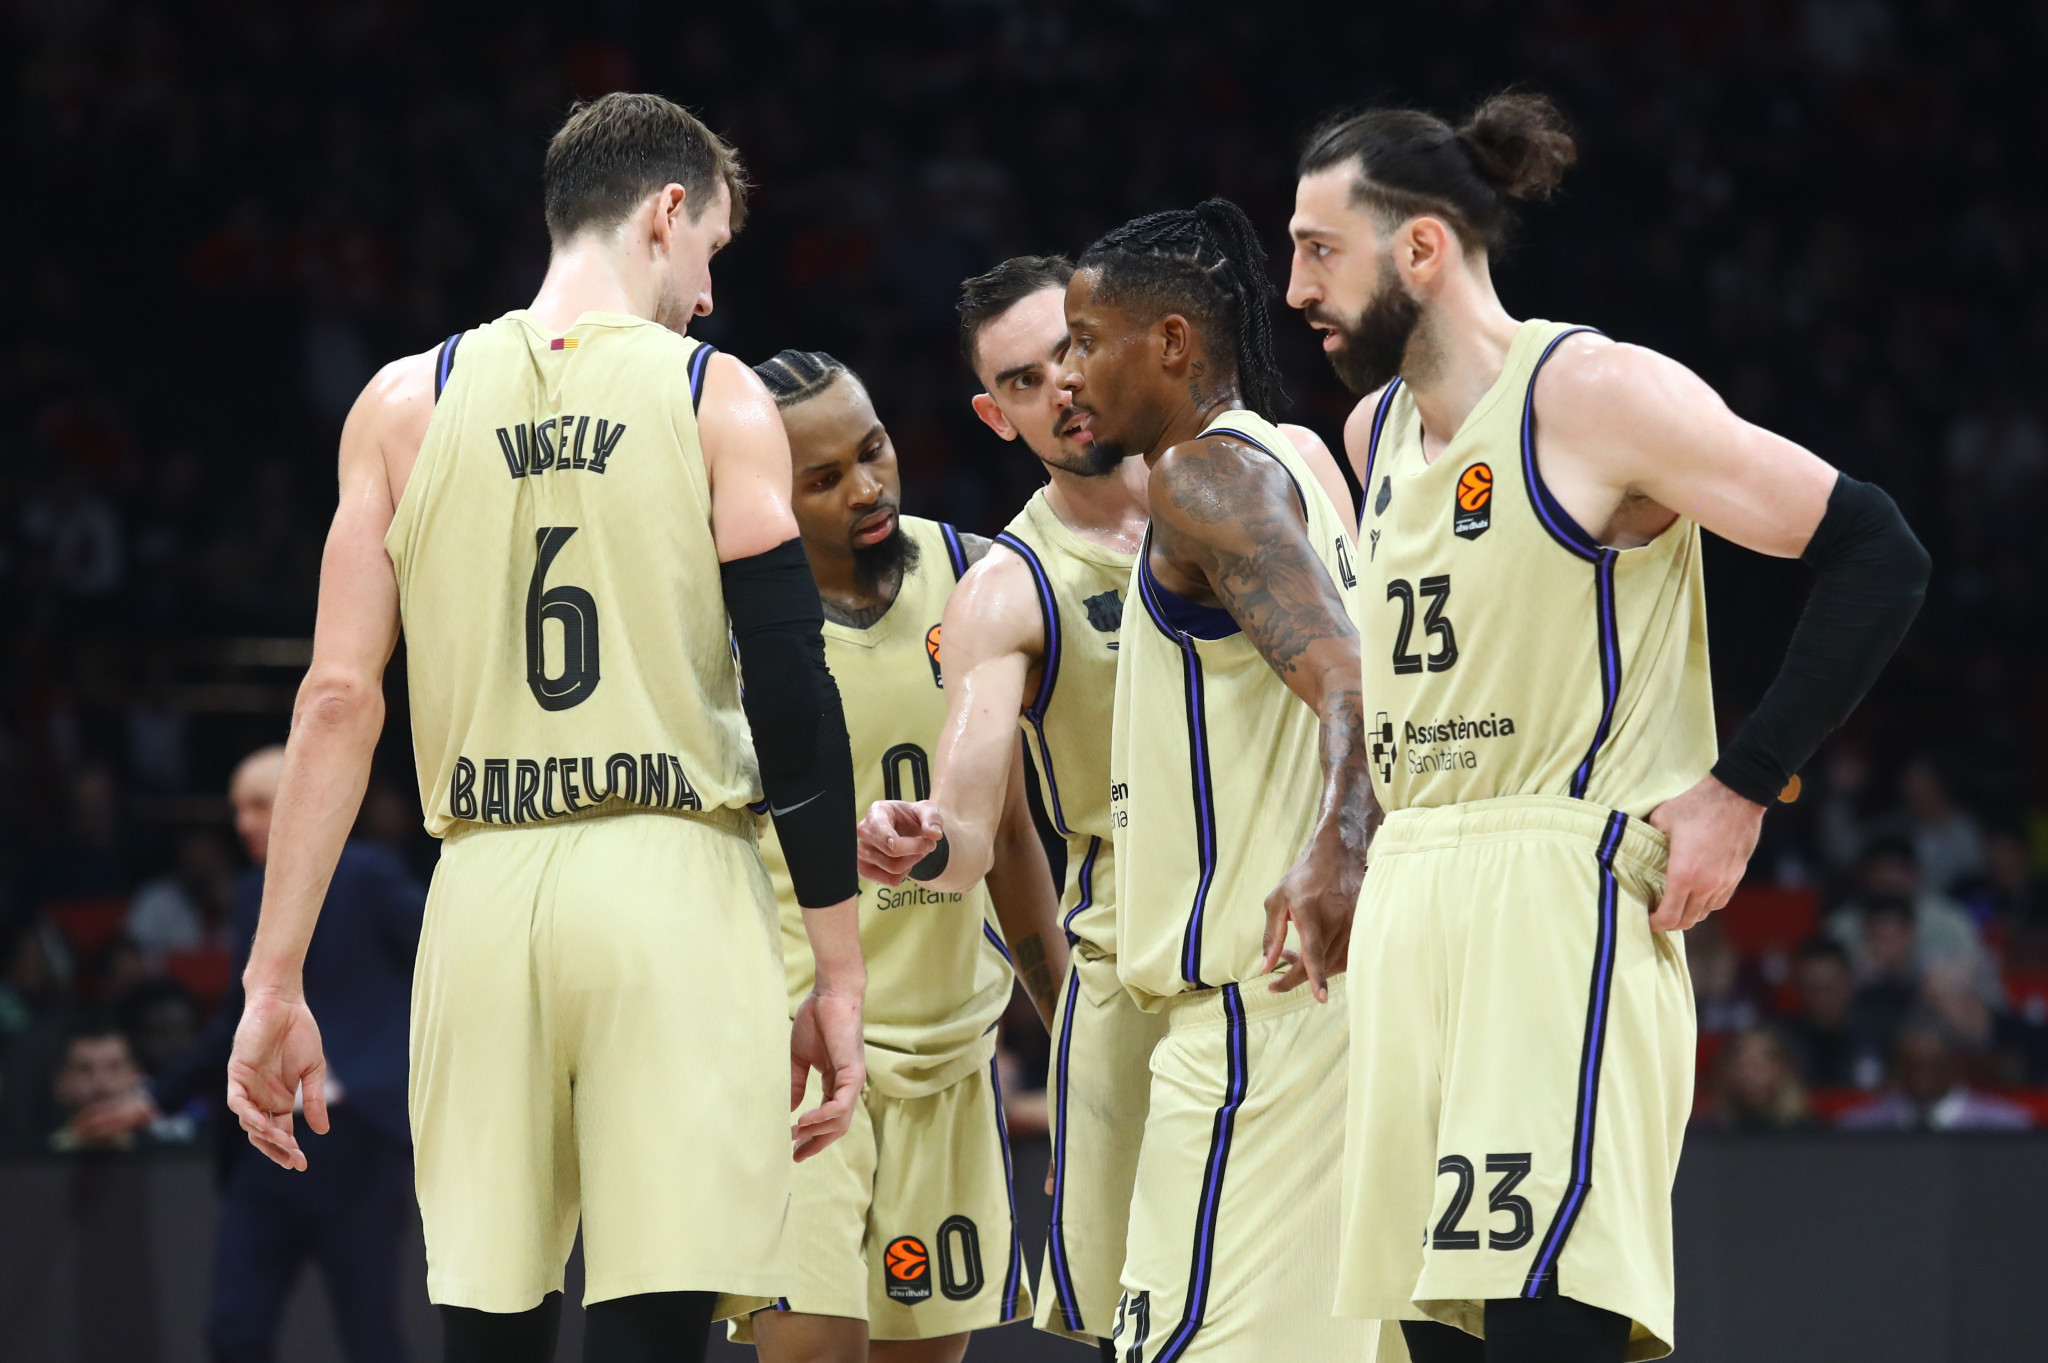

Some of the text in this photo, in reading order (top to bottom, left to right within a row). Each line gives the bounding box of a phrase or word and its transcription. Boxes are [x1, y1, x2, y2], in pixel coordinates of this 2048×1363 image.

[526, 526, 600, 712] 6
[1386, 574, 1459, 675] 23
[1405, 712, 1515, 745] Assistència
[1407, 744, 1477, 774] Sanitària
[450, 752, 702, 824] BARCELONA
[1432, 1152, 1534, 1251] 23
[936, 1214, 985, 1301] 0
